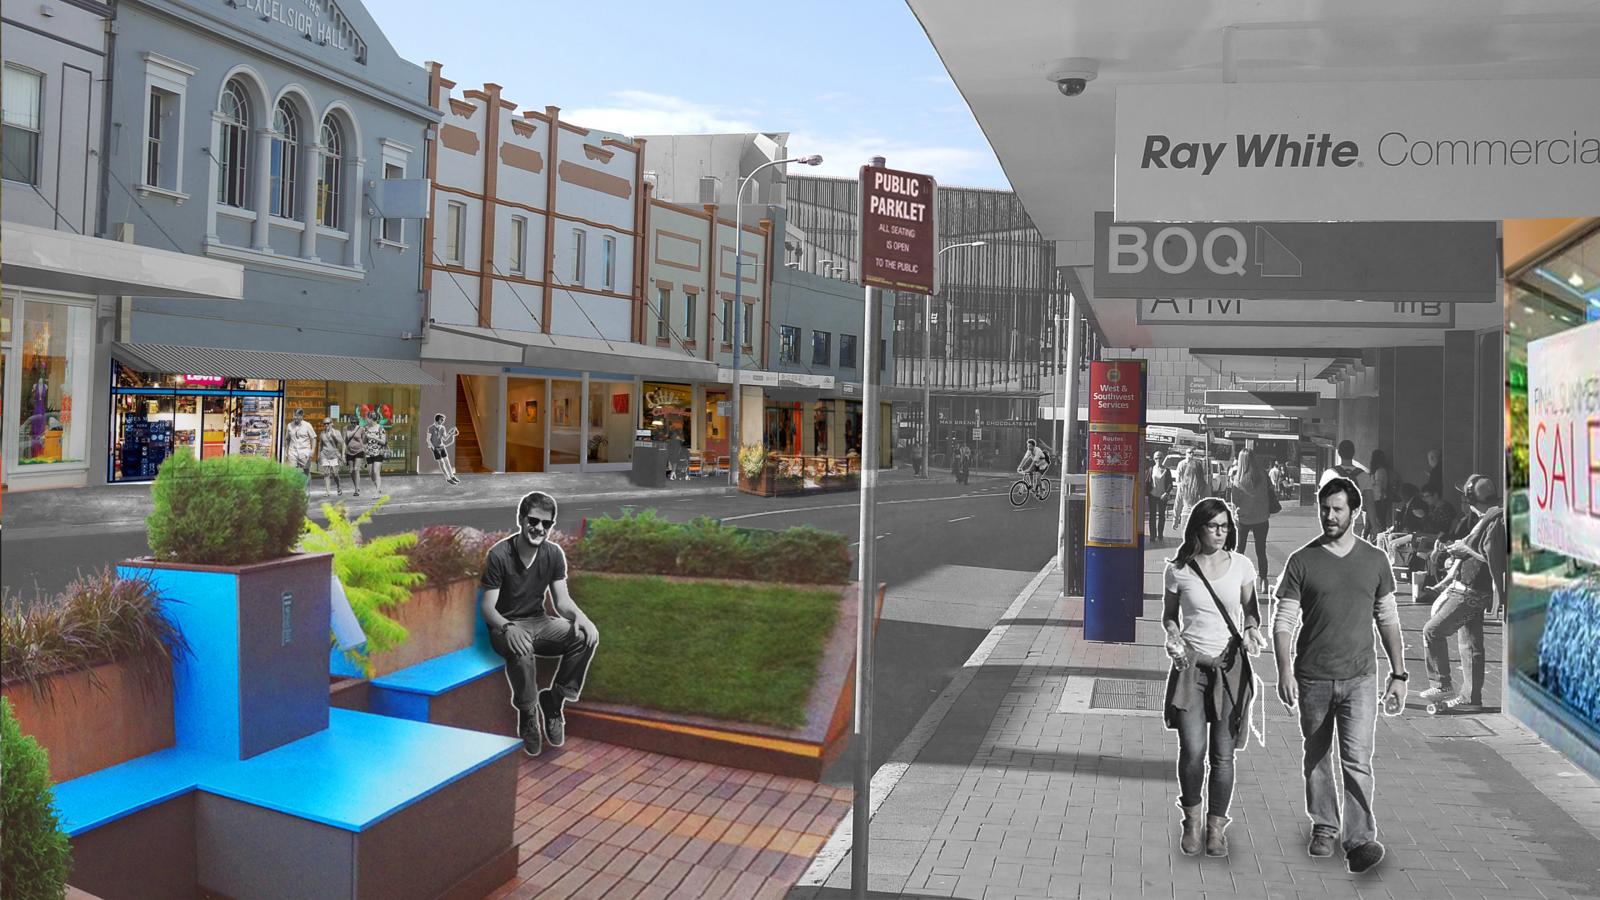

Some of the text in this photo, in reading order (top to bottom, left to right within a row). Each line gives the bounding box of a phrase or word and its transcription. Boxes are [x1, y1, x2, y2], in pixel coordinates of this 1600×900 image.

[246, 0, 345, 50] EXCELSIOR HALL
[1140, 134, 1228, 175] Ray
[1236, 133, 1359, 168] White
[875, 172, 919, 197] PUBLIC
[870, 195, 926, 222] PARKLET
[878, 223, 916, 238] ALL SEATING
[886, 240, 910, 253] IS OPEN
[1108, 226, 1247, 276] BOQ
[875, 257, 919, 274] TO THE PUBLIC
[1093, 392, 1134, 401] Southwest
[1100, 384, 1128, 392] West &
[1097, 400, 1129, 409] Services
[1187, 406, 1217, 414] Medical
[1536, 418, 1600, 519] SALE
